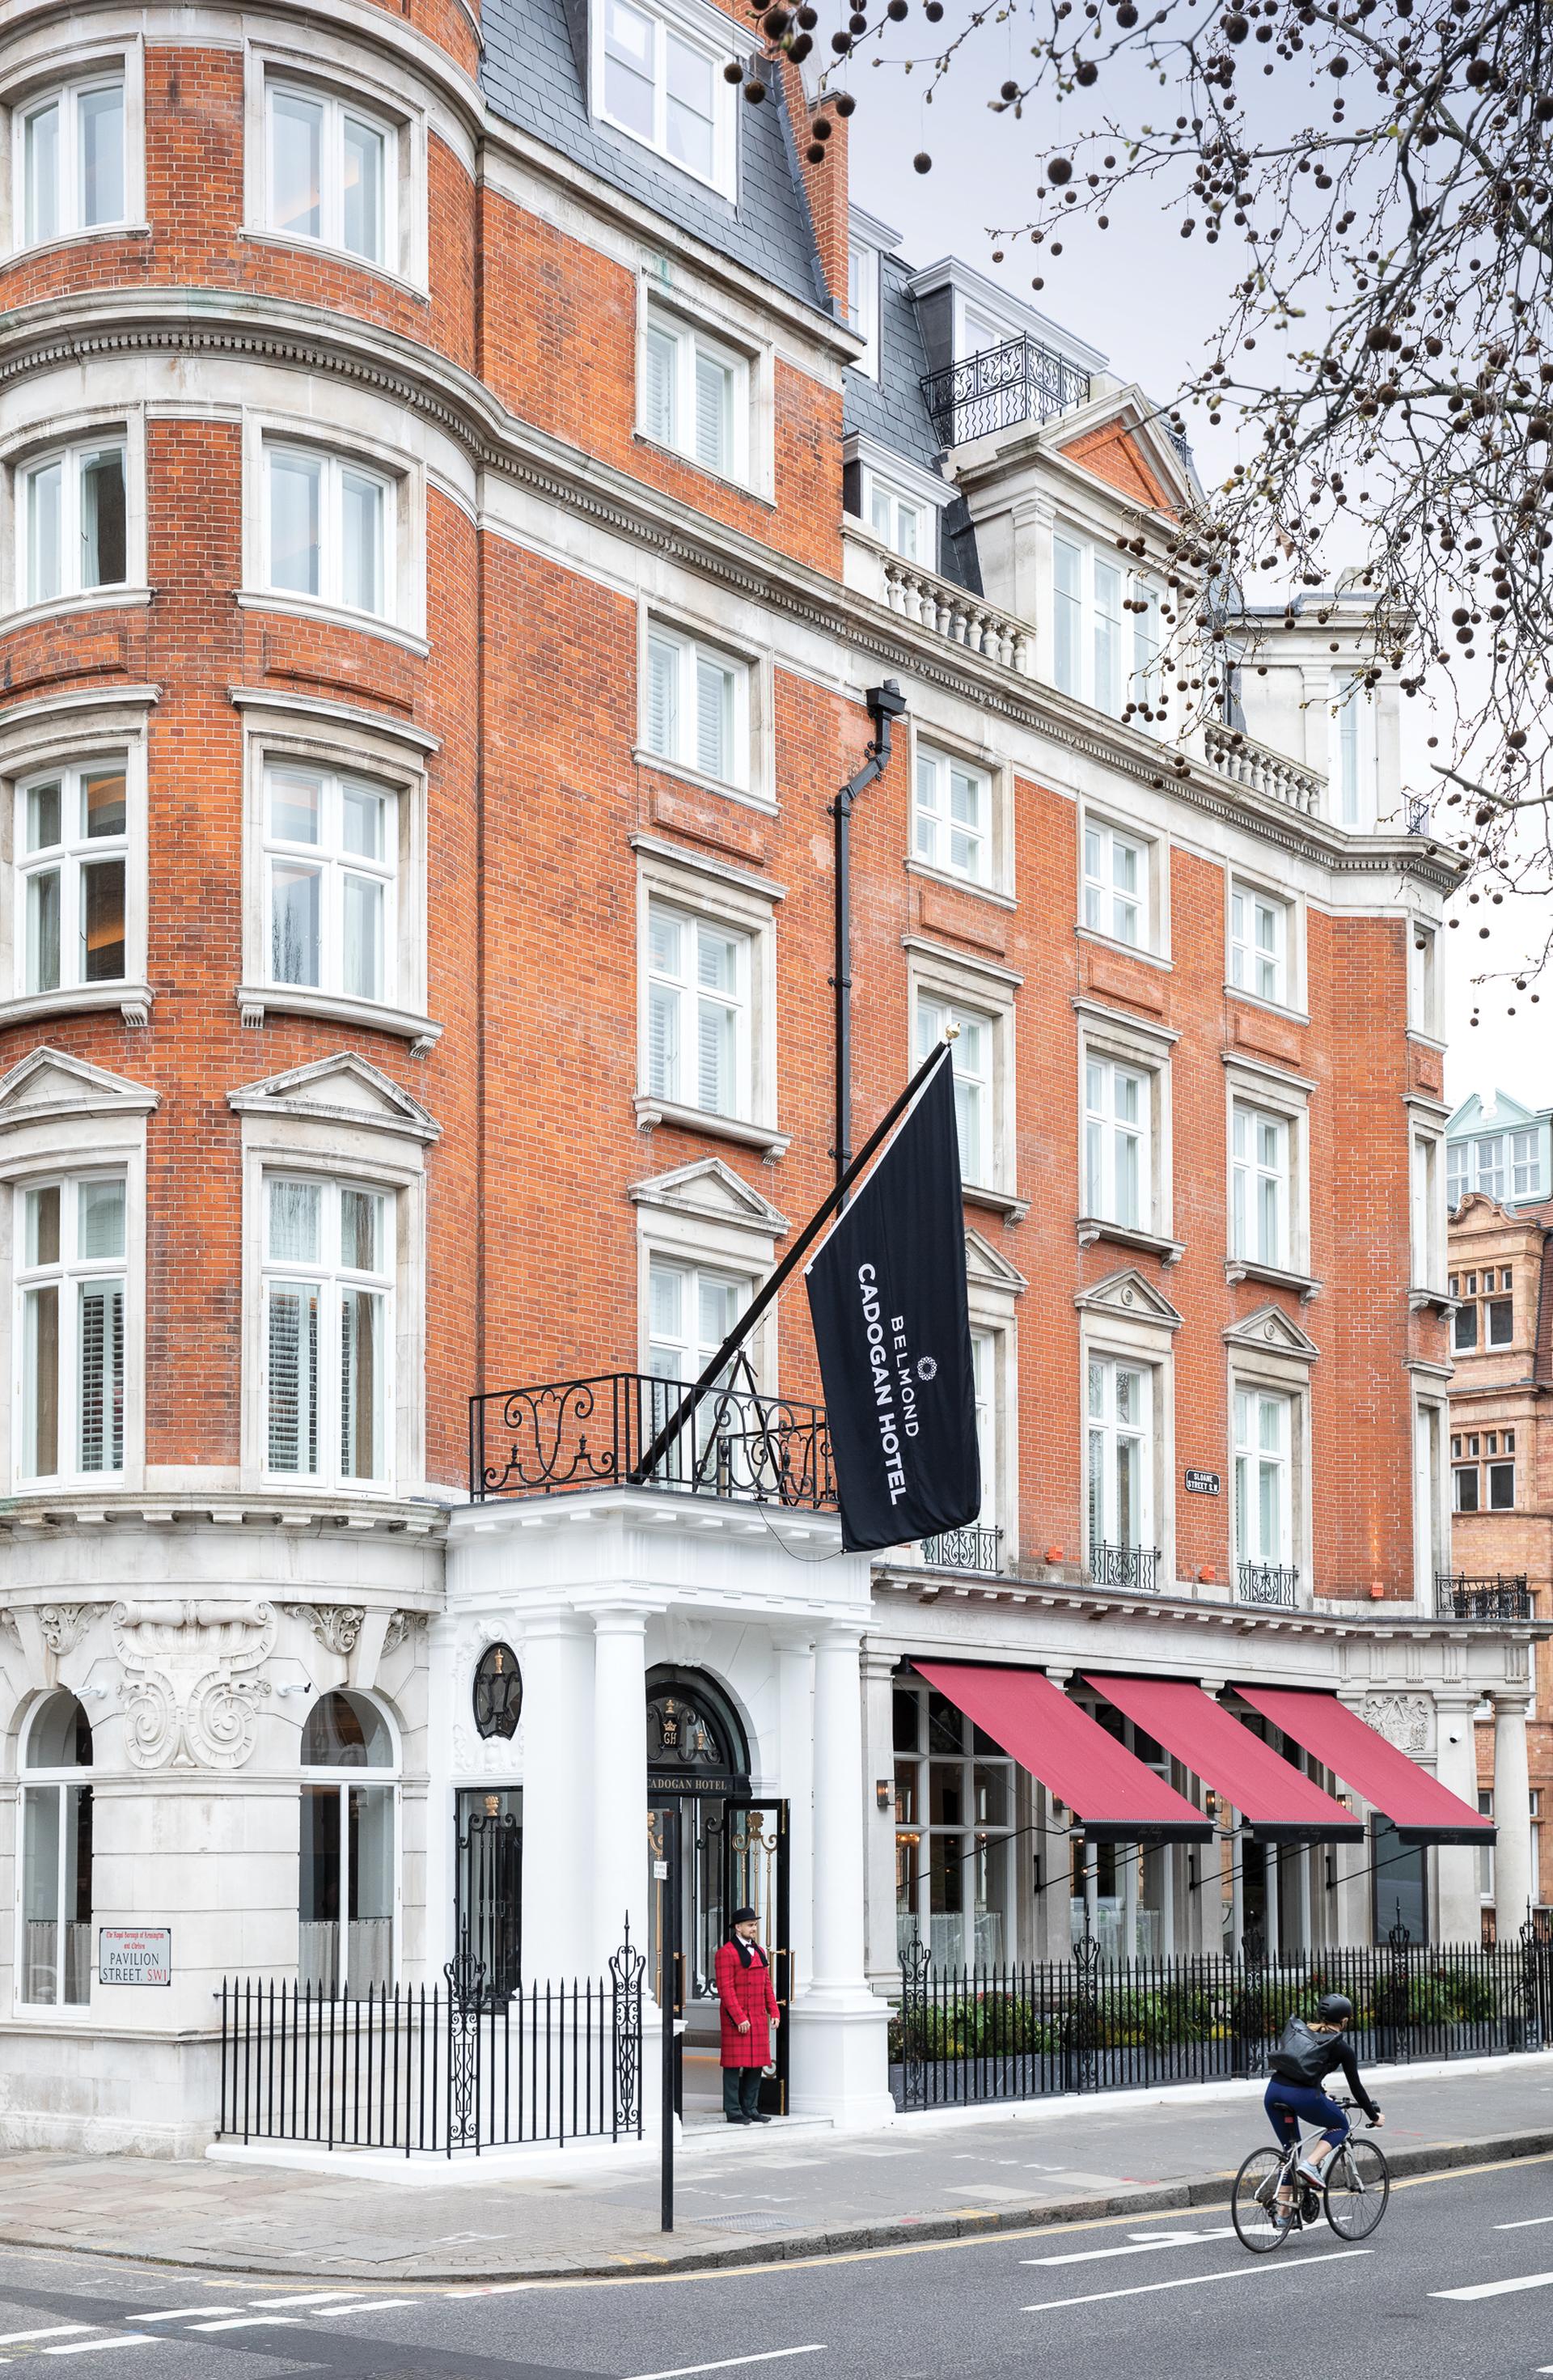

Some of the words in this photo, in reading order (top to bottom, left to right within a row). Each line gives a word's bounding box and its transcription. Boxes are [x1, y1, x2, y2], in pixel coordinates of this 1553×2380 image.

[891, 1315, 920, 1437] BELMOND
[857, 1263, 893, 1406] CADOGAN
[878, 1412, 907, 1505] HOTEL
[1193, 1472, 1213, 1483] SLOANE
[1187, 1480, 1208, 1490] STREET
[695, 1780, 727, 1790] HOTEL
[110, 1952, 159, 1966] PAVILION
